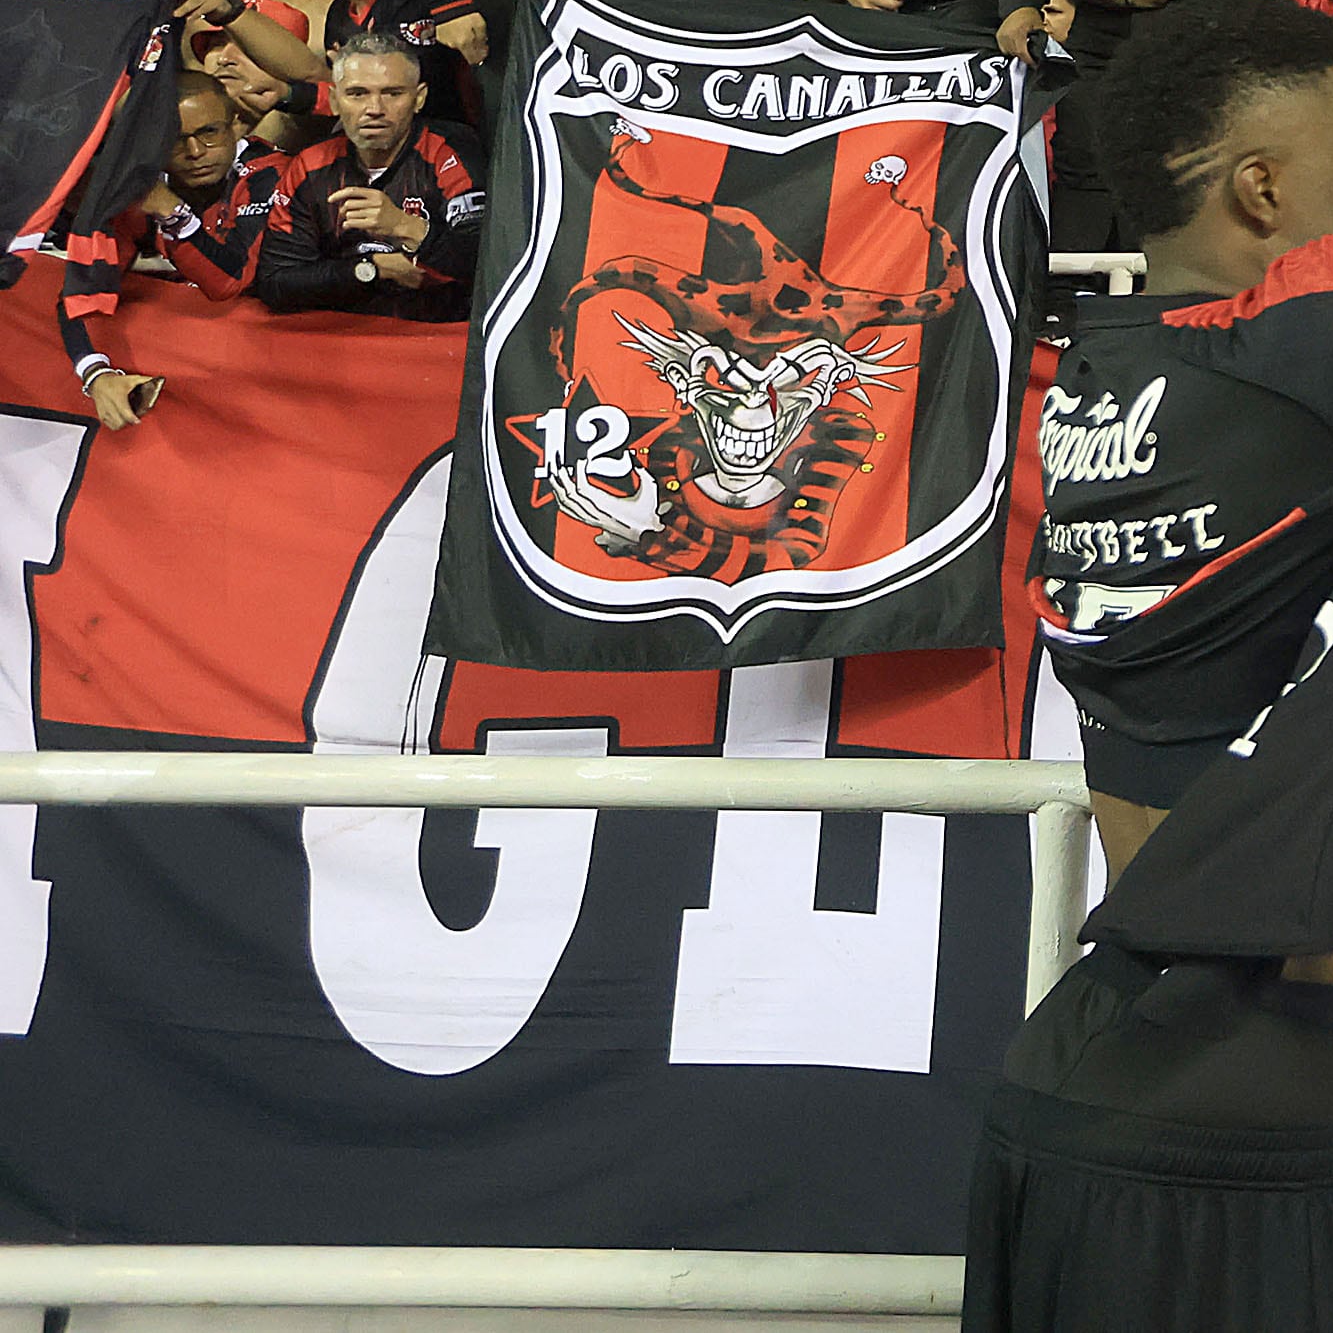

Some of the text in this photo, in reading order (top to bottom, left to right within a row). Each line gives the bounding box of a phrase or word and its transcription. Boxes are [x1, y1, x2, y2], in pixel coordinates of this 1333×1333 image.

[572, 44, 1010, 121] LOS CANALLAS
[534, 404, 637, 479] 12
